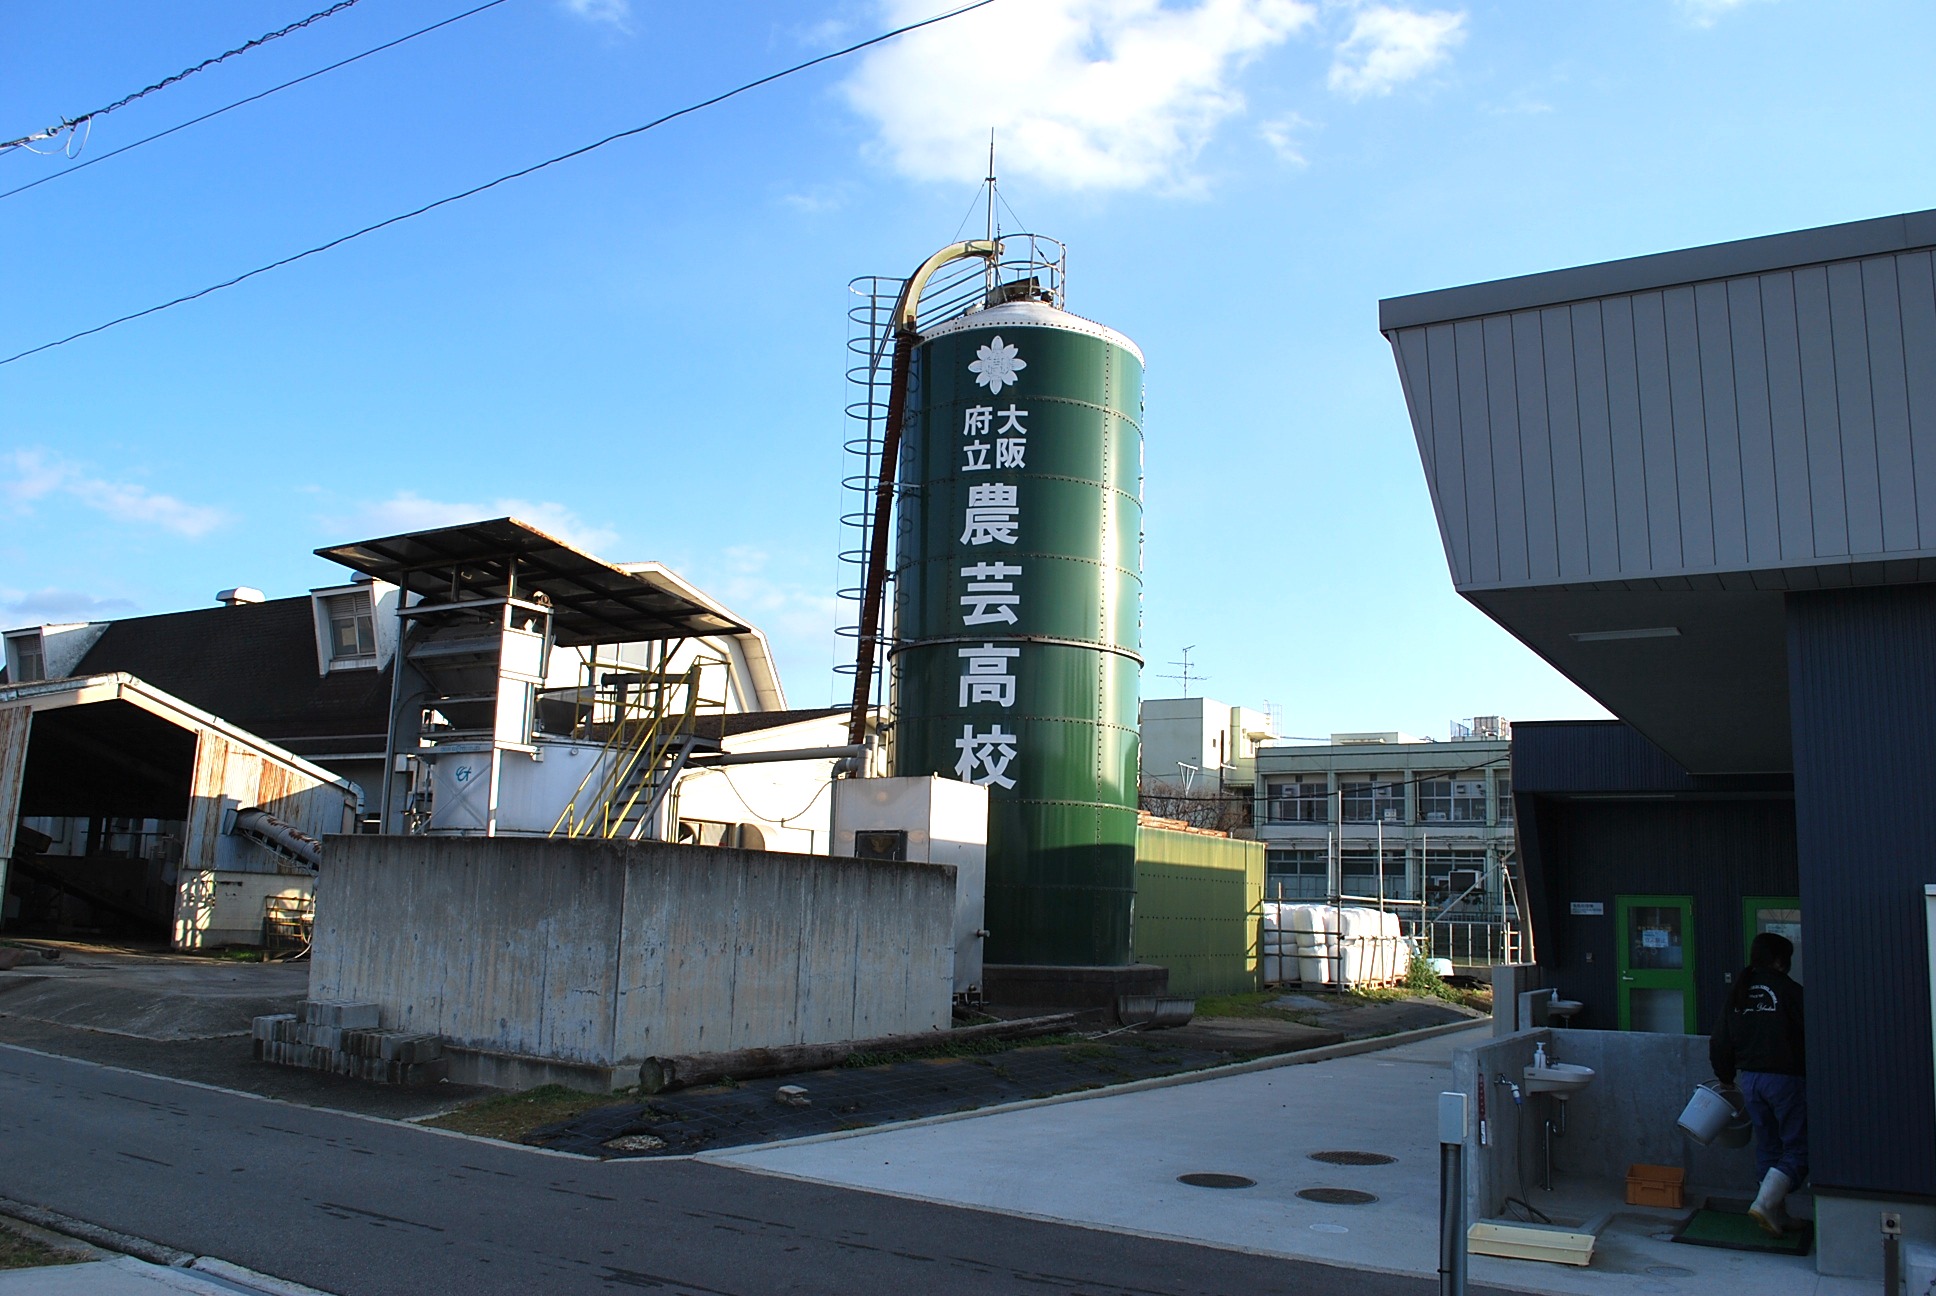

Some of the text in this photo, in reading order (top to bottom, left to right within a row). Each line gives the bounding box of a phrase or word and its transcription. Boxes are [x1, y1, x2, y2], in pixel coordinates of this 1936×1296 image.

[961, 404, 993, 472] 府立
[996, 403, 1029, 469] 大阪
[954, 482, 1023, 791] 農芸高校
